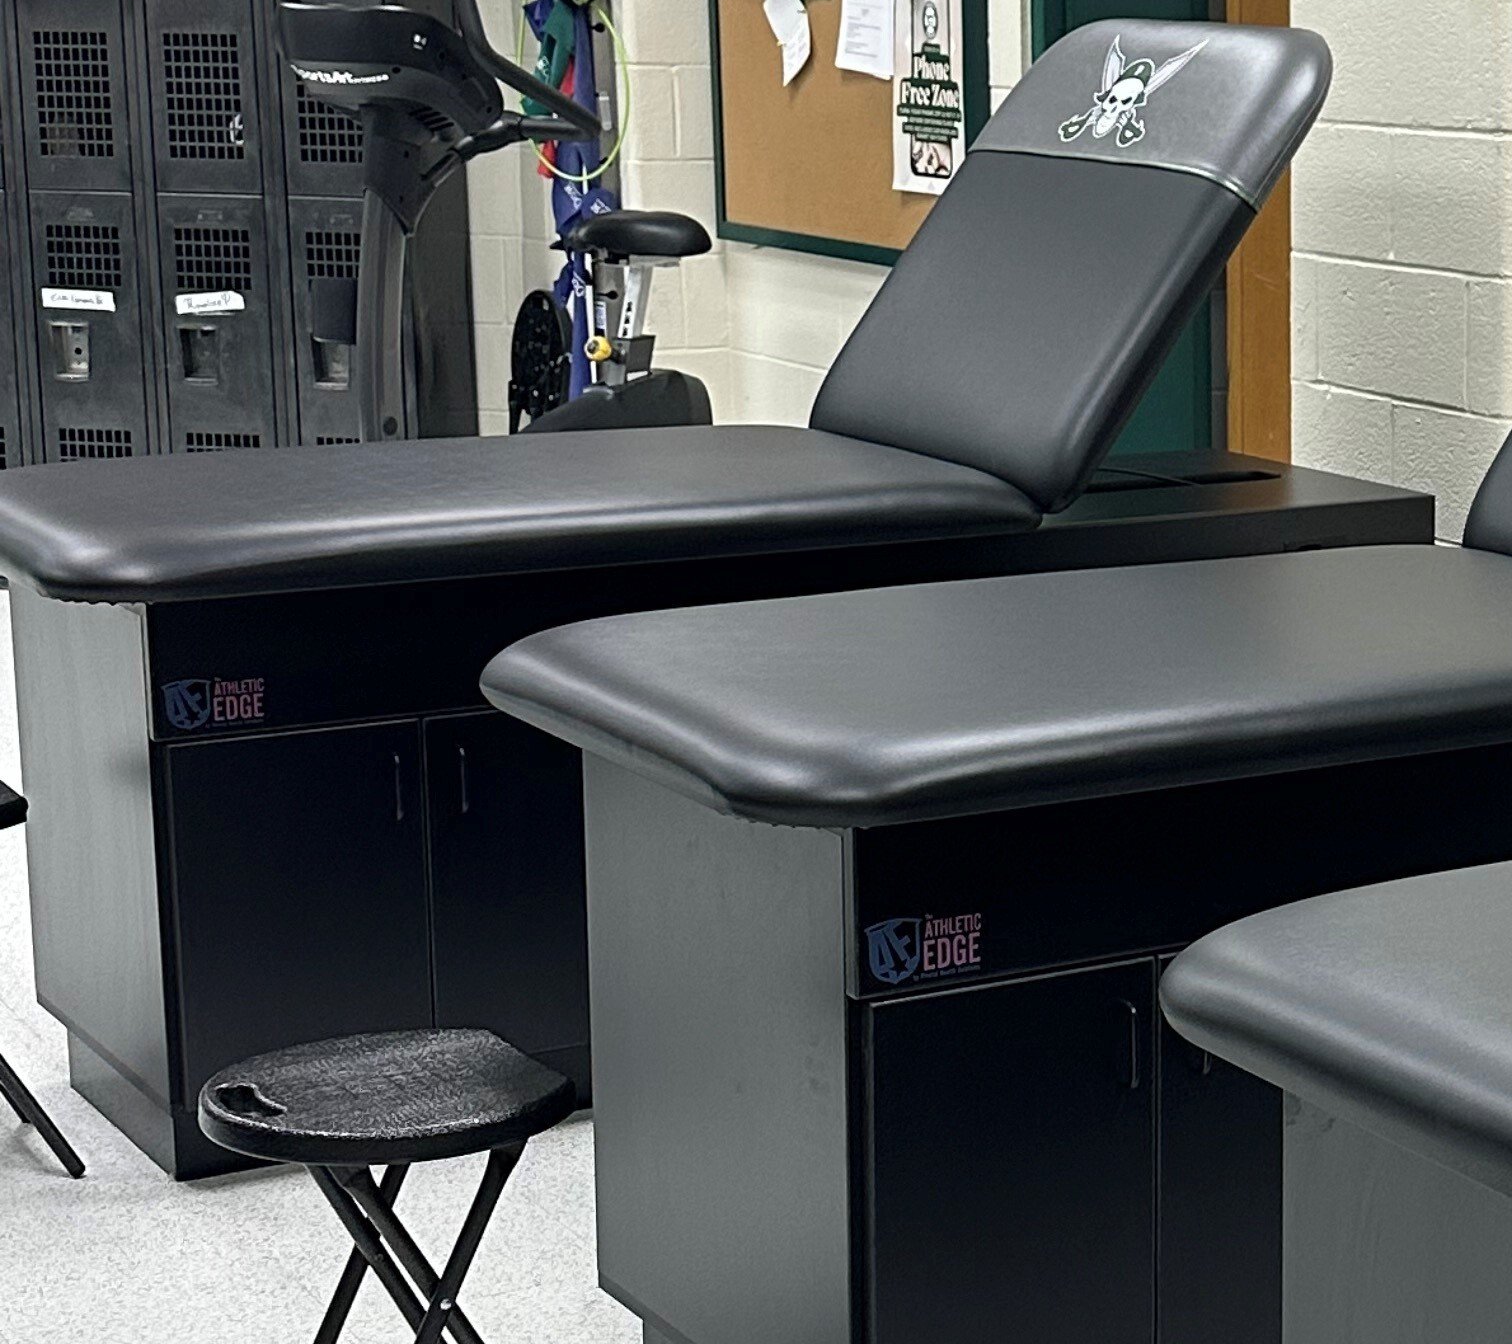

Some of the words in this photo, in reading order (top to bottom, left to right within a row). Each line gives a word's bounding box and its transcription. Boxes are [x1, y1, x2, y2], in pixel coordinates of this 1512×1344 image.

[912, 56, 950, 81] Phone
[901, 81, 931, 106] Free
[931, 83, 959, 108] Zone
[214, 678, 265, 696] ATHLETIC
[213, 693, 265, 721] EDGE
[925, 913, 981, 938] ATHLETIC
[923, 932, 981, 971] EDGE
